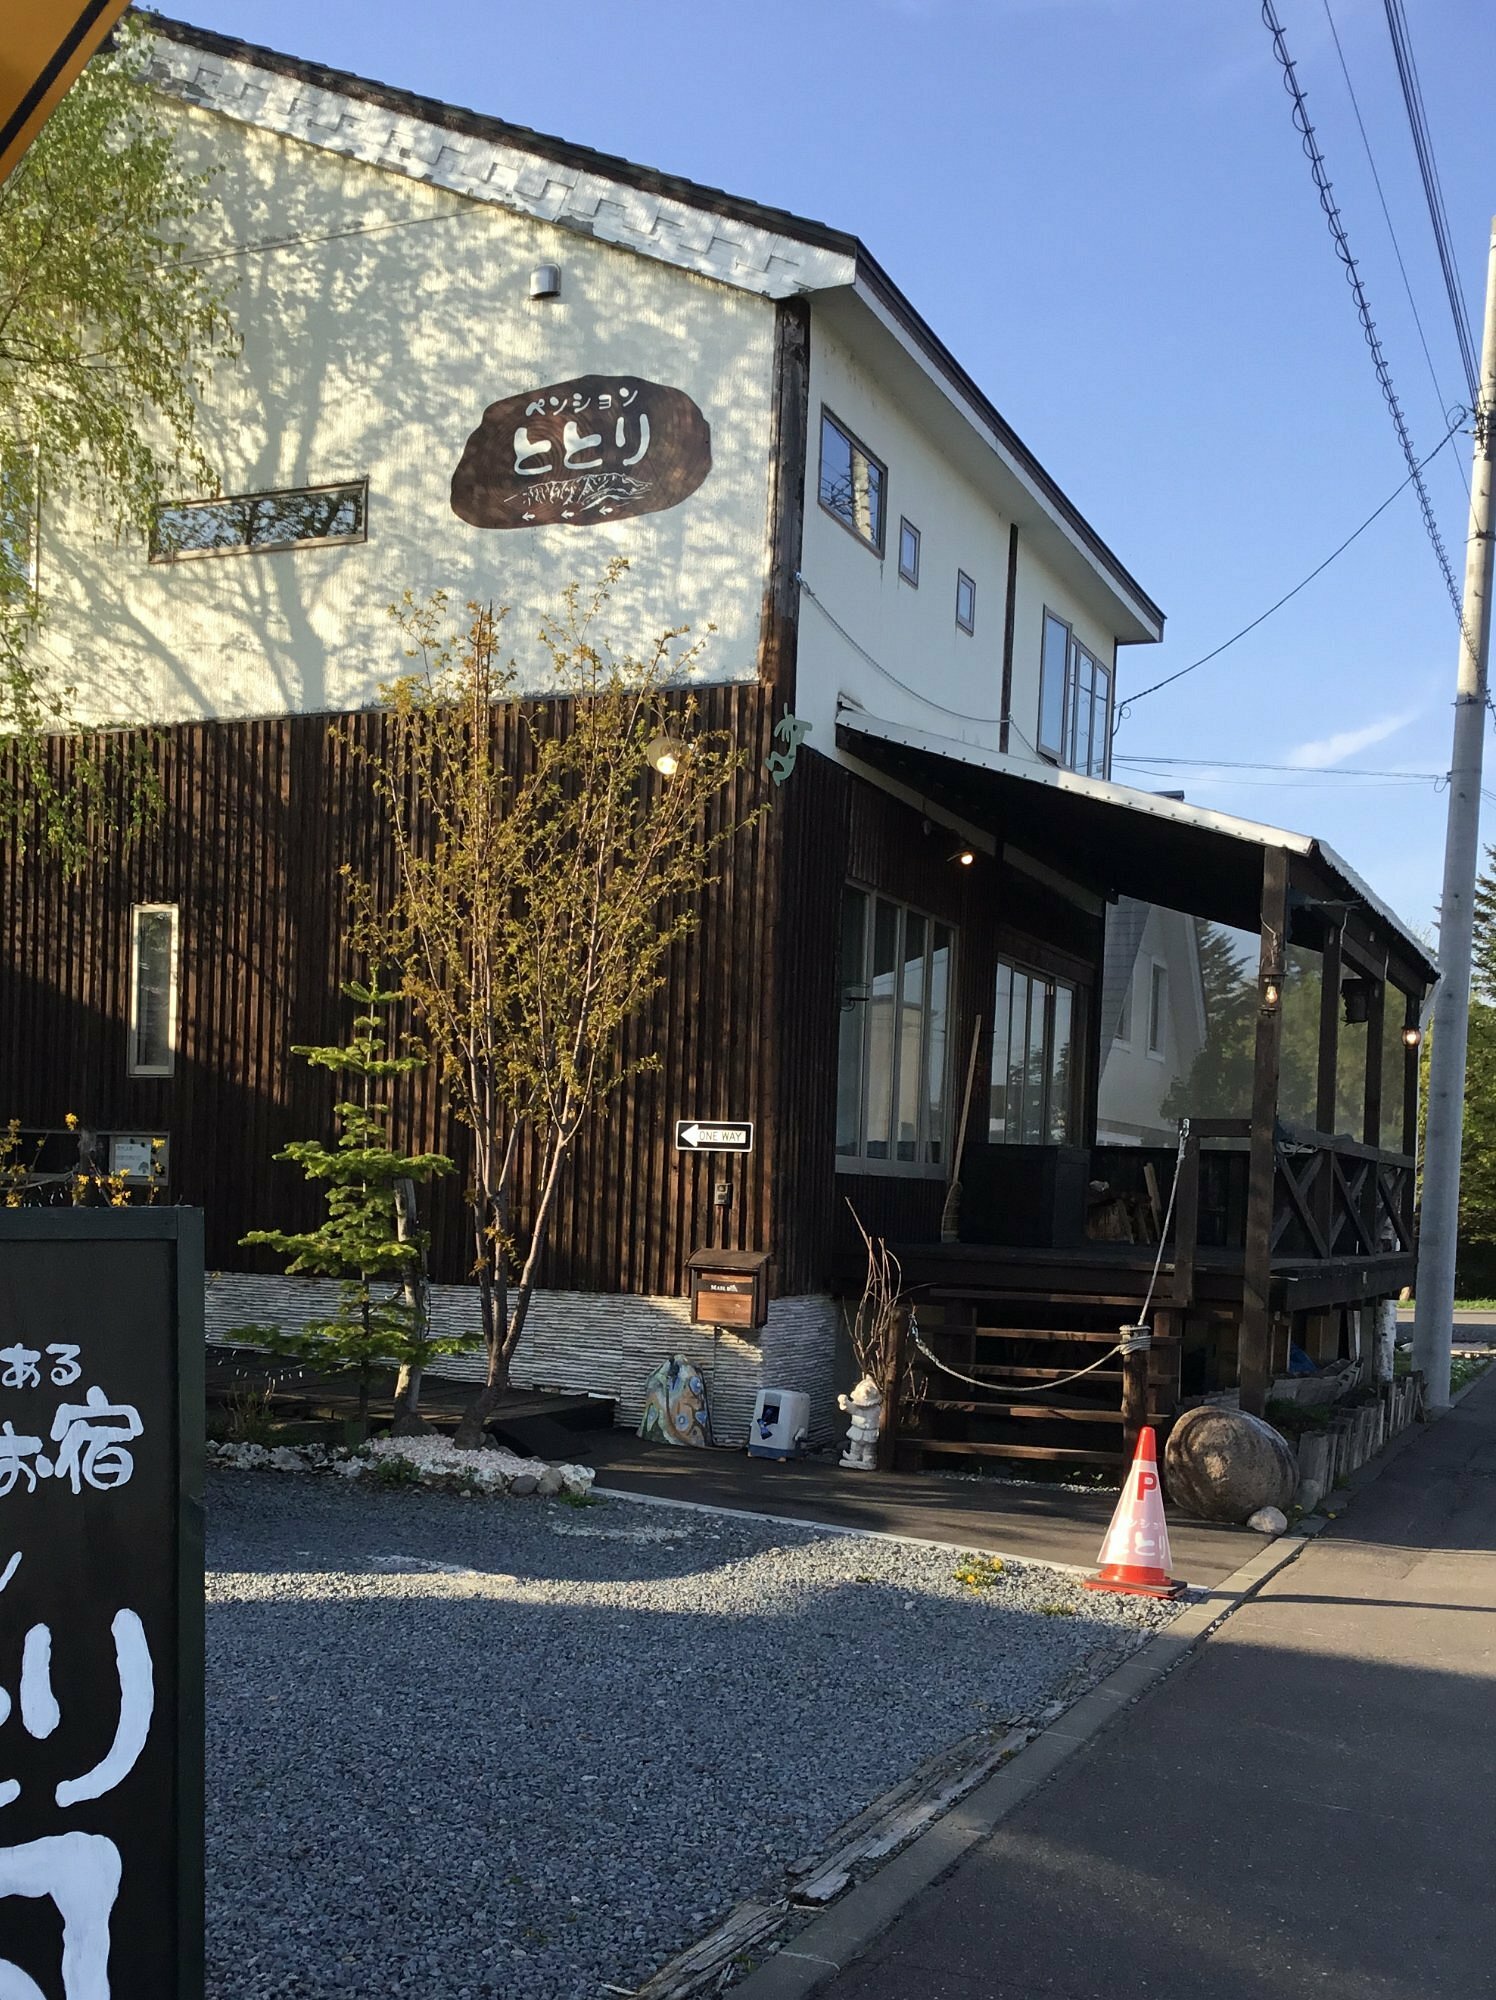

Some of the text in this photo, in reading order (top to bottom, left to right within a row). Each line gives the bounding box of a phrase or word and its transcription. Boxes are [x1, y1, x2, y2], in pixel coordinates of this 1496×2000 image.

[525, 387, 638, 416] ペンション
[699, 1130, 742, 1141] ONE WAY
[1136, 1471, 1157, 1501] P
